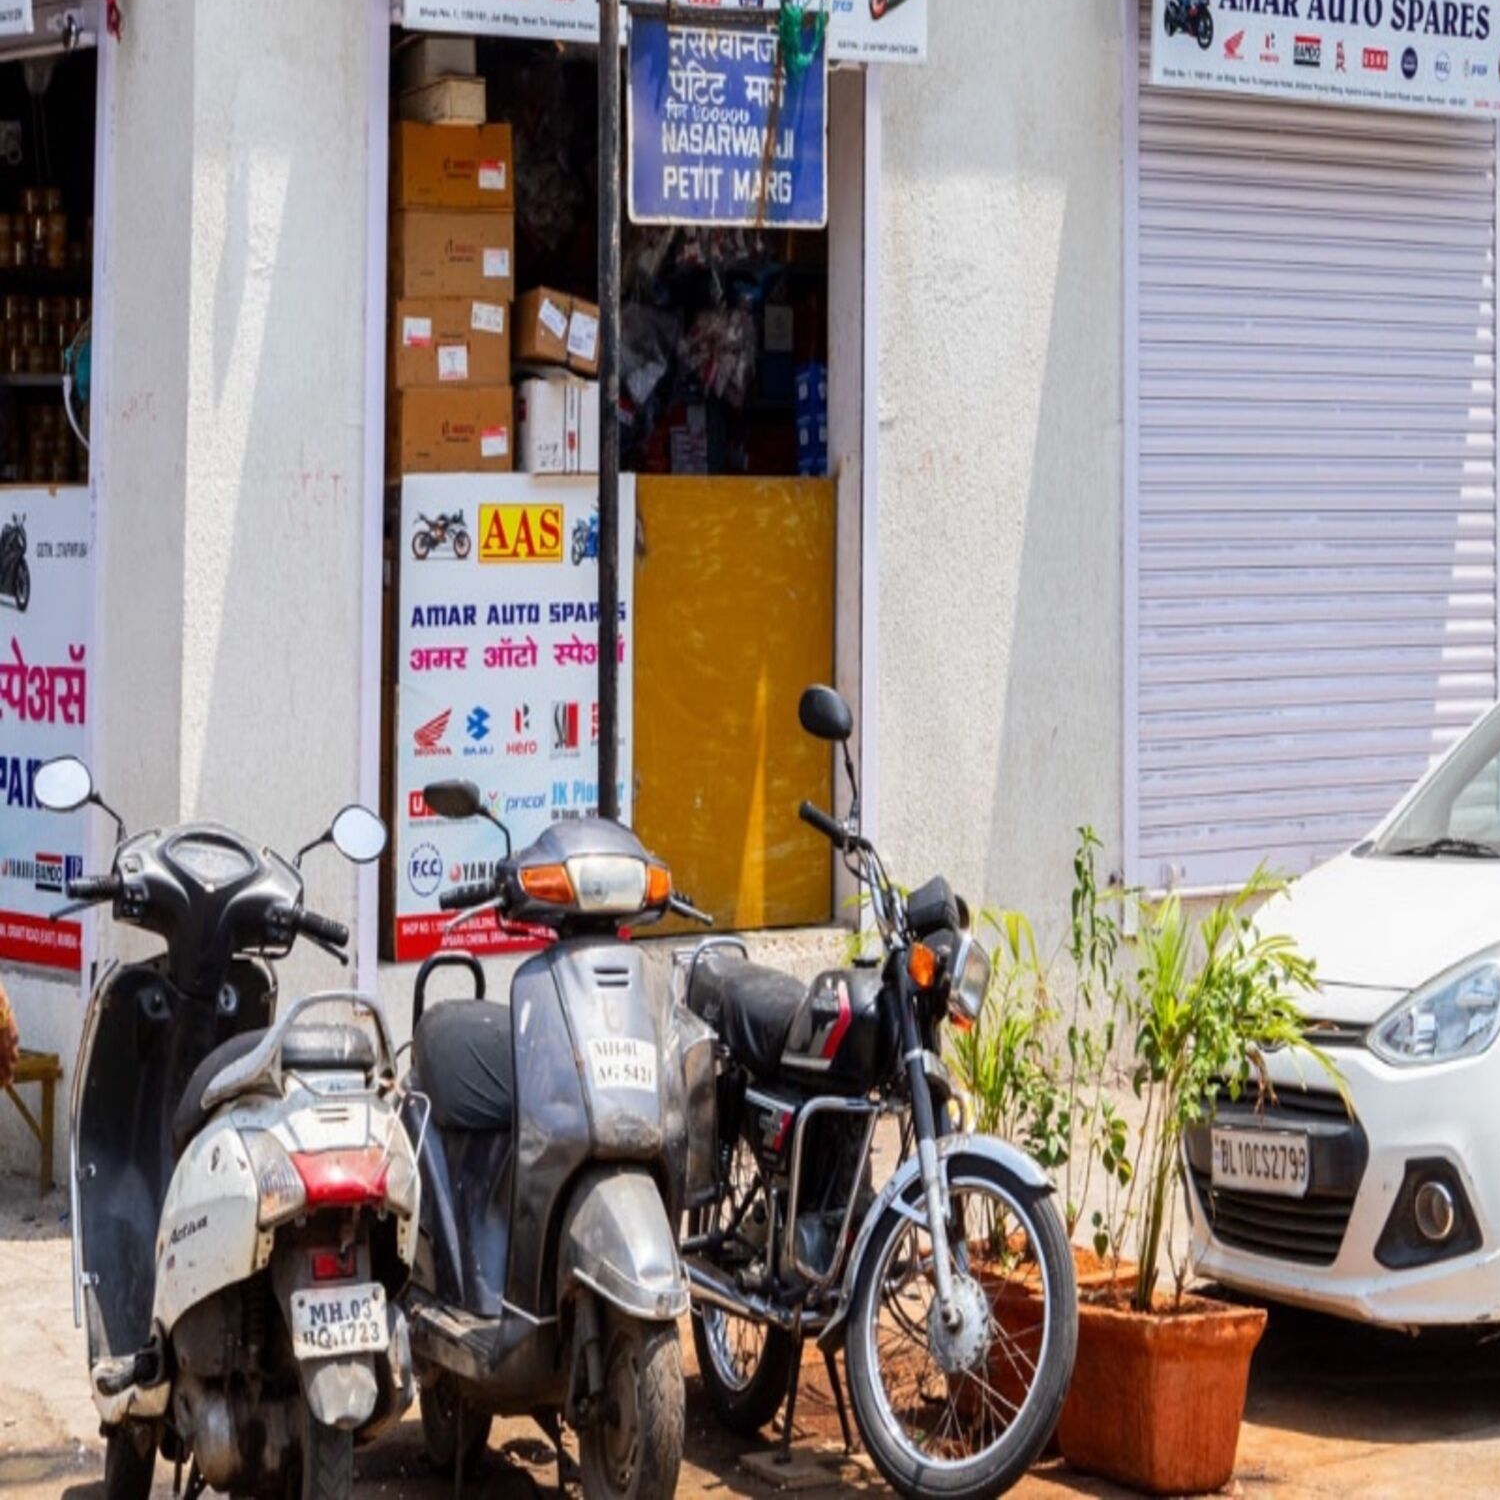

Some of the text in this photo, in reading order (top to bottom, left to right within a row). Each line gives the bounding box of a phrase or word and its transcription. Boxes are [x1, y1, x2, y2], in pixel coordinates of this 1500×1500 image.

[662, 164, 793, 204] PETIT MARG
[481, 508, 561, 559] AAS
[410, 601, 627, 629] AMAR AUTO SPARS
[409, 645, 468, 671] अमर
[482, 635, 538, 669] ऑटो
[505, 791, 547, 815] pricol
[462, 862, 498, 881] YAMA
